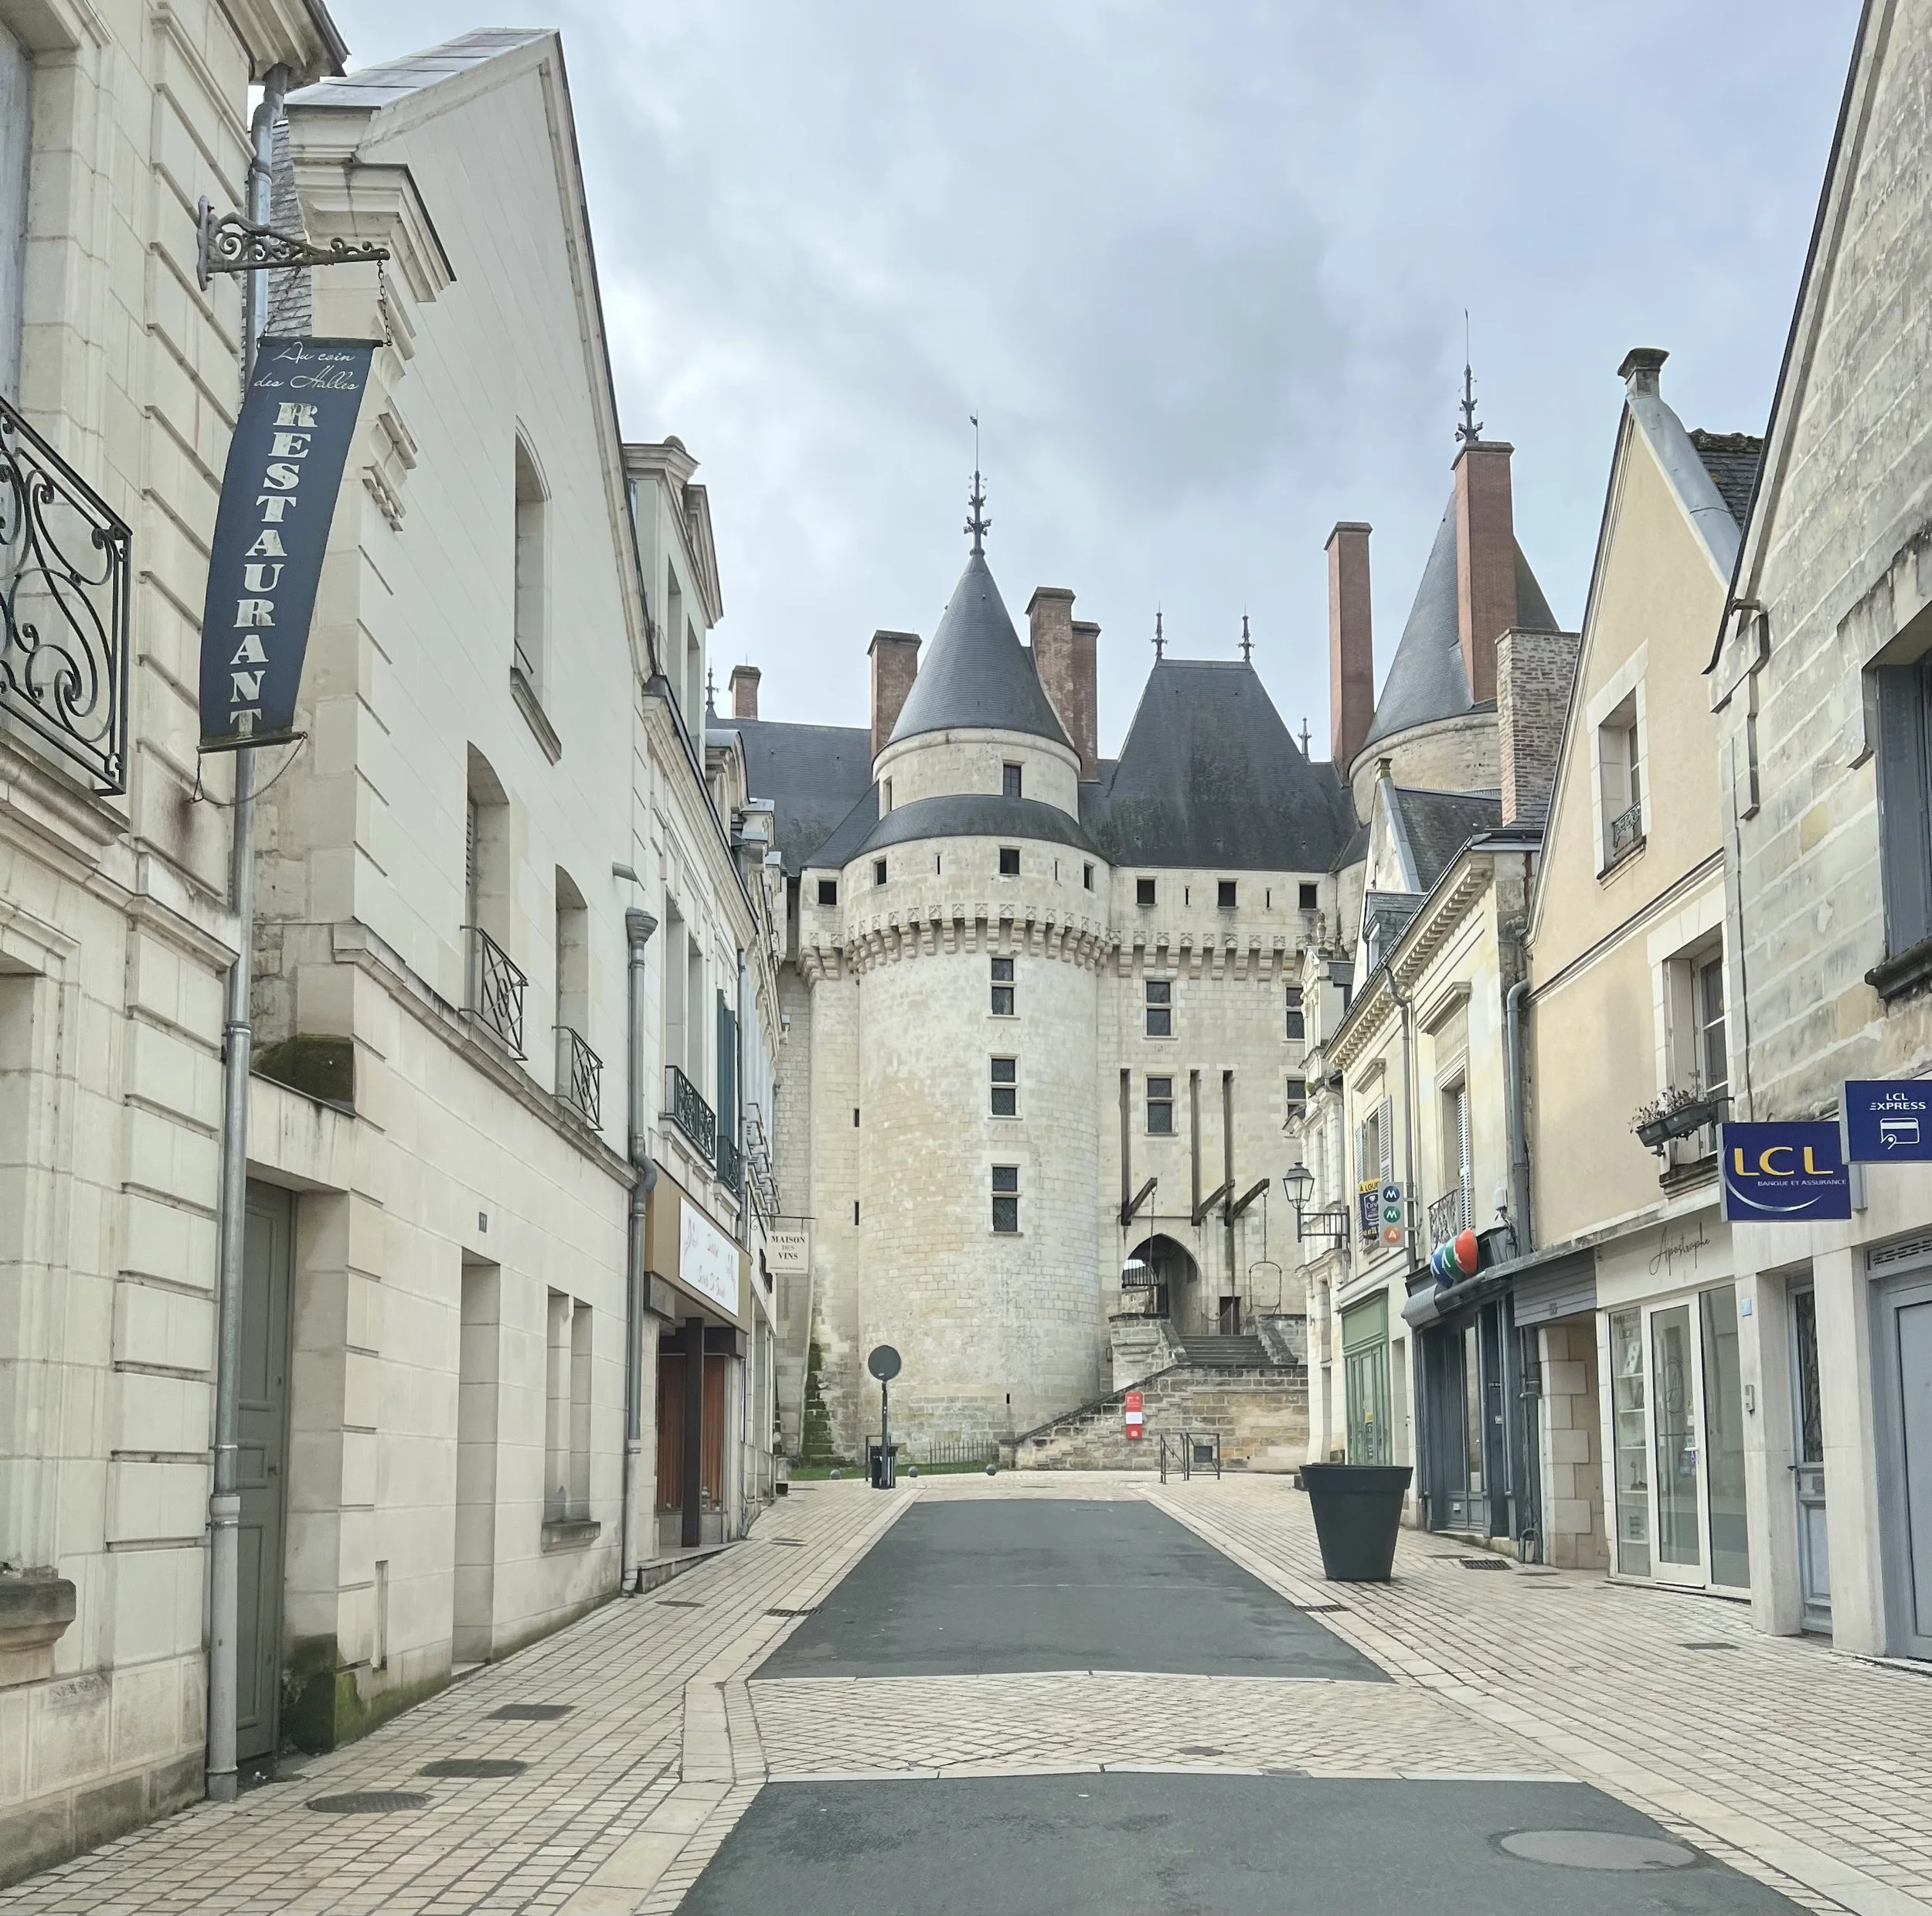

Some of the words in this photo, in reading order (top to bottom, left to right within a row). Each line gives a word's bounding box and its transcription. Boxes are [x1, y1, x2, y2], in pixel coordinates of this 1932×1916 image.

[272, 342, 315, 364] Au
[318, 352, 356, 362] coin
[253, 372, 284, 387] des
[290, 365, 359, 390] Halles
[229, 401, 318, 739] RESTAURANT
[1869, 1101, 1927, 1111] EXPRESS
[1733, 1146, 1834, 1176] LCL
[1649, 1221, 1711, 1276] Apostrophe
